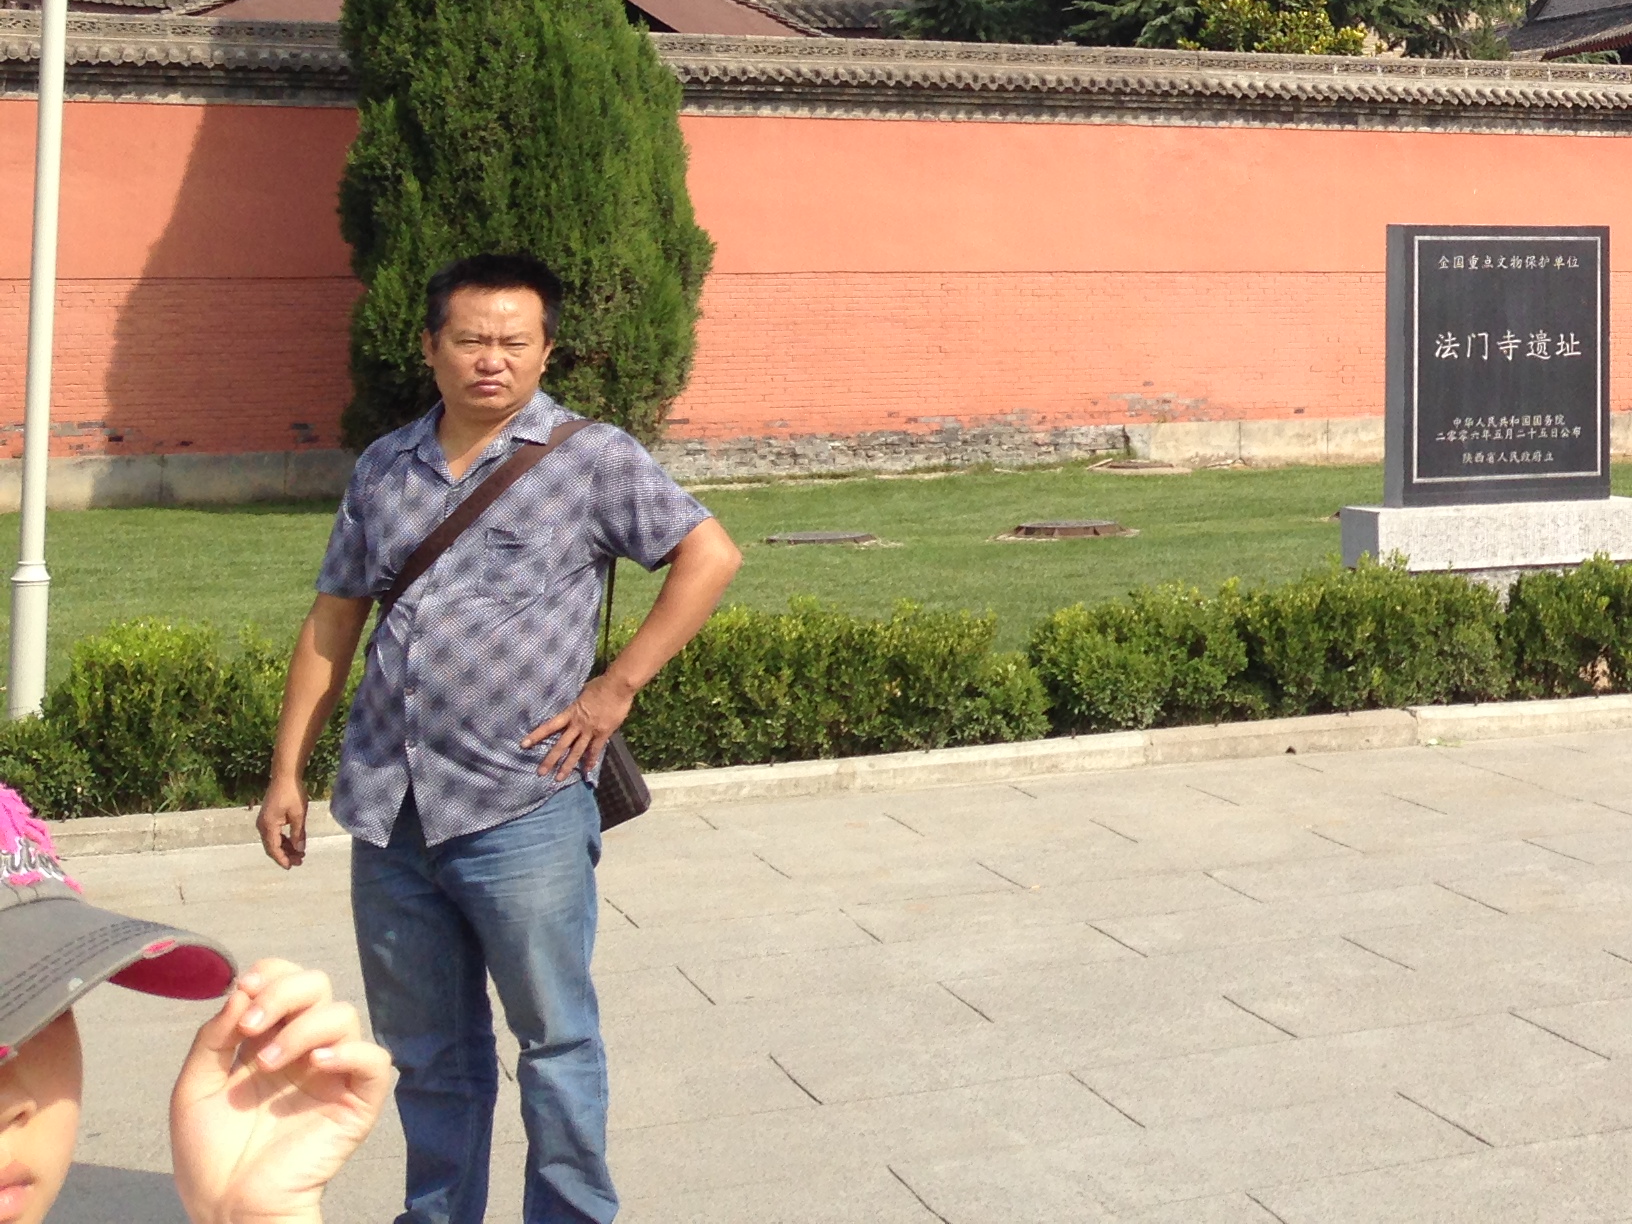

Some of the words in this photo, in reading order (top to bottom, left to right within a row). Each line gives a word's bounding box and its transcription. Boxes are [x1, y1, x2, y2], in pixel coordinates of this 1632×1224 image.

[1437, 254, 1580, 271] 全国重点文物保护单位
[1434, 329, 1582, 362] 法门寺遗址
[1452, 414, 1566, 429] 中华人民共和国国务院
[1461, 449, 1555, 465] 陕西省人民政府立
